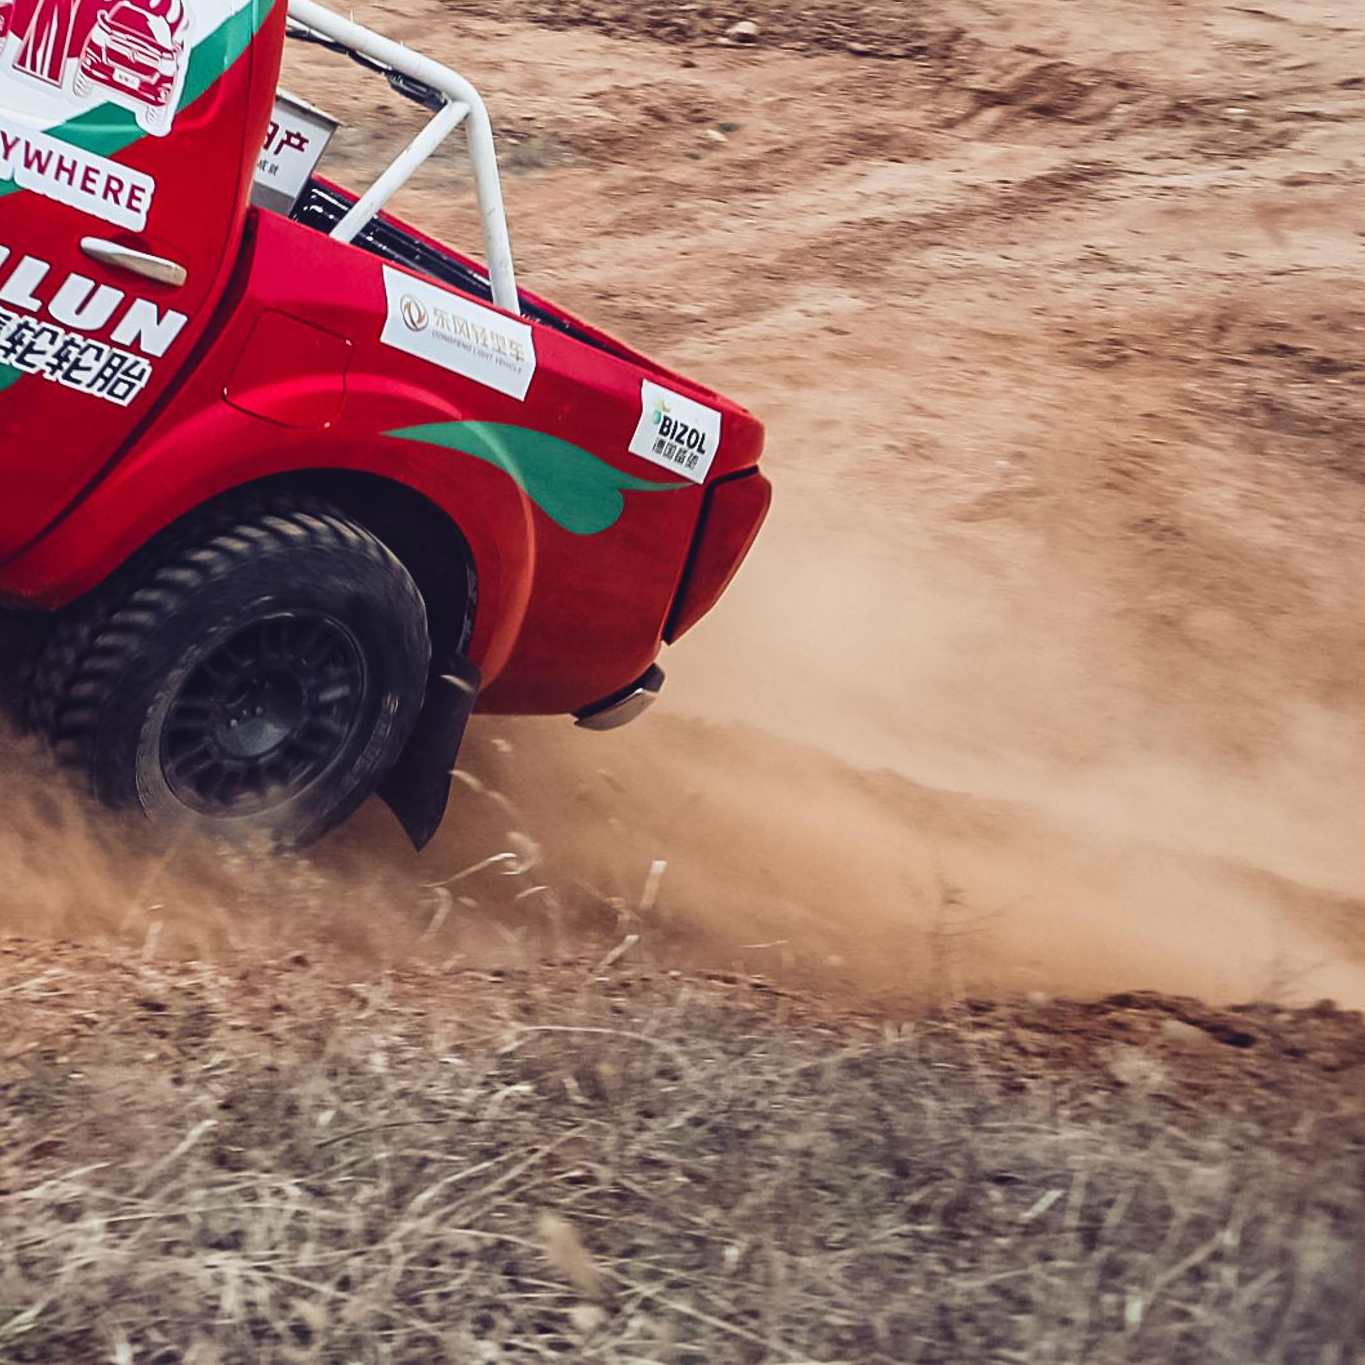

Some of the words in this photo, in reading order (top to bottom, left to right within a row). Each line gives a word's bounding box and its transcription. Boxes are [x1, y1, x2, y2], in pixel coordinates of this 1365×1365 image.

[433, 306, 525, 362] 东风轻型车
[658, 415, 706, 455] BIZOL
